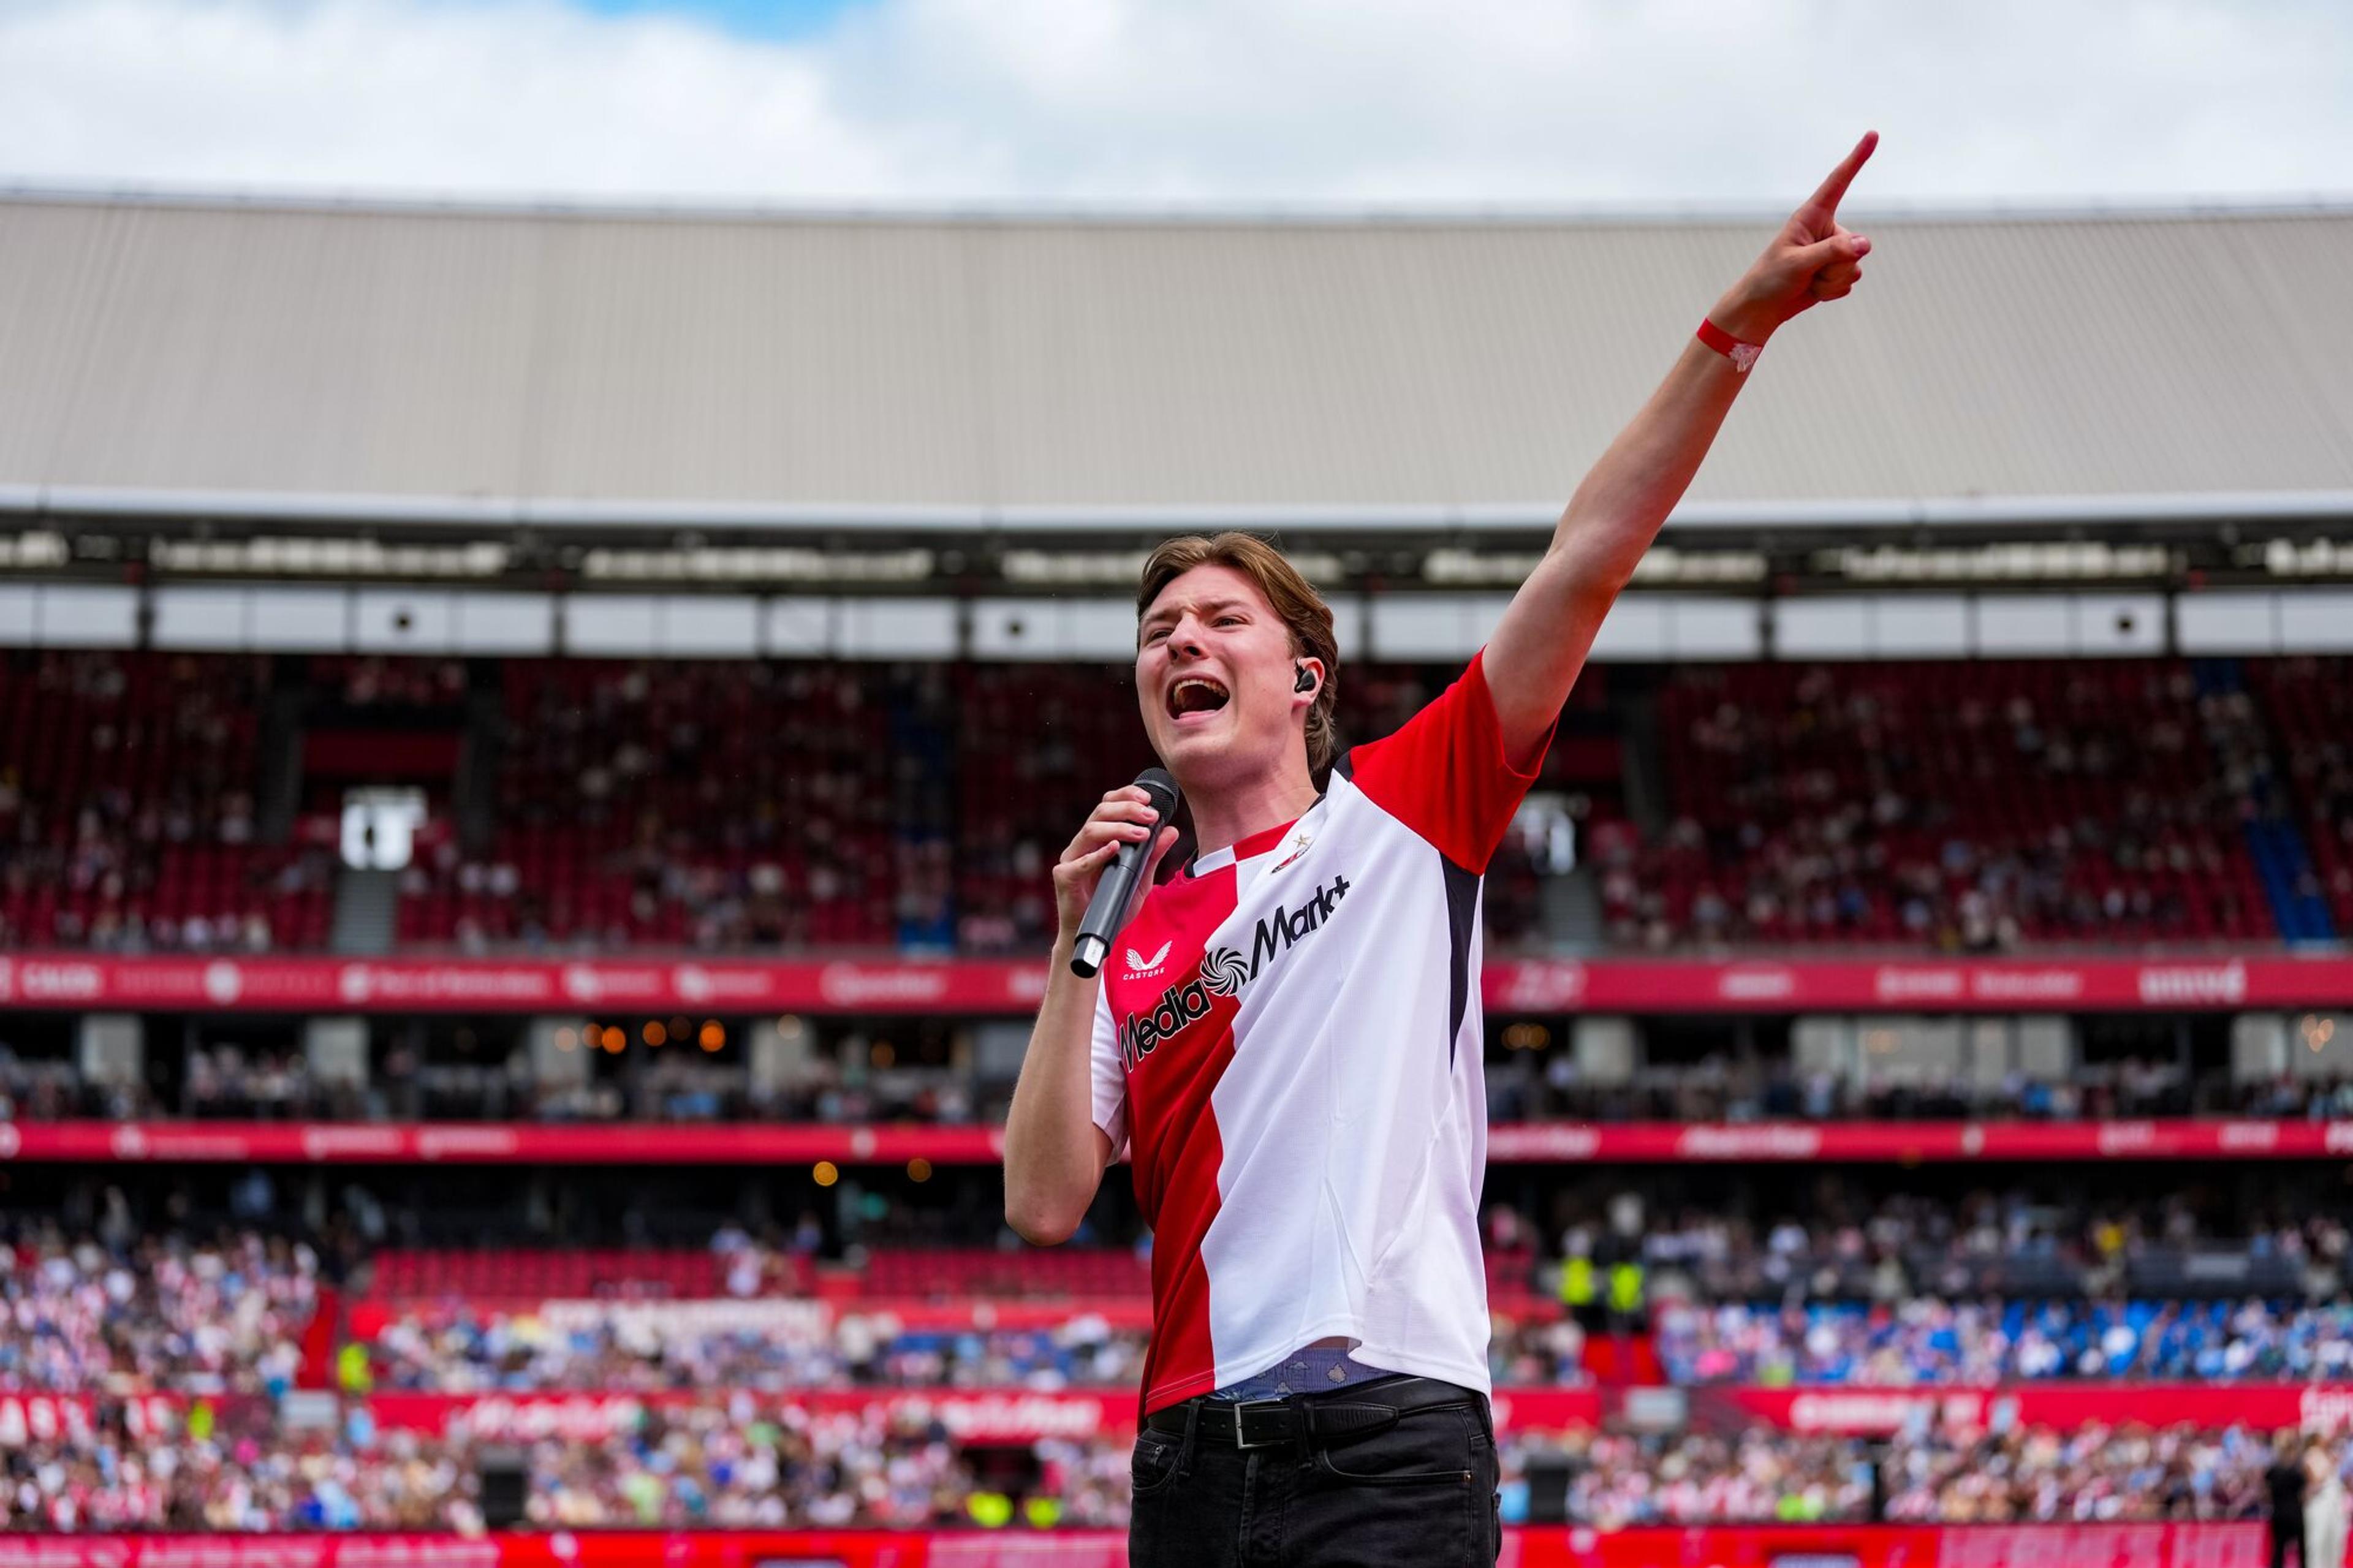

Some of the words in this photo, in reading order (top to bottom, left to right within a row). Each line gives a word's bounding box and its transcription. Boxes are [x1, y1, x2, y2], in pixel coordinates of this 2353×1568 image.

[1120, 979, 1213, 1073] Media
[1249, 875, 1350, 981] Markt
[1123, 967, 1165, 980] CASTORE
